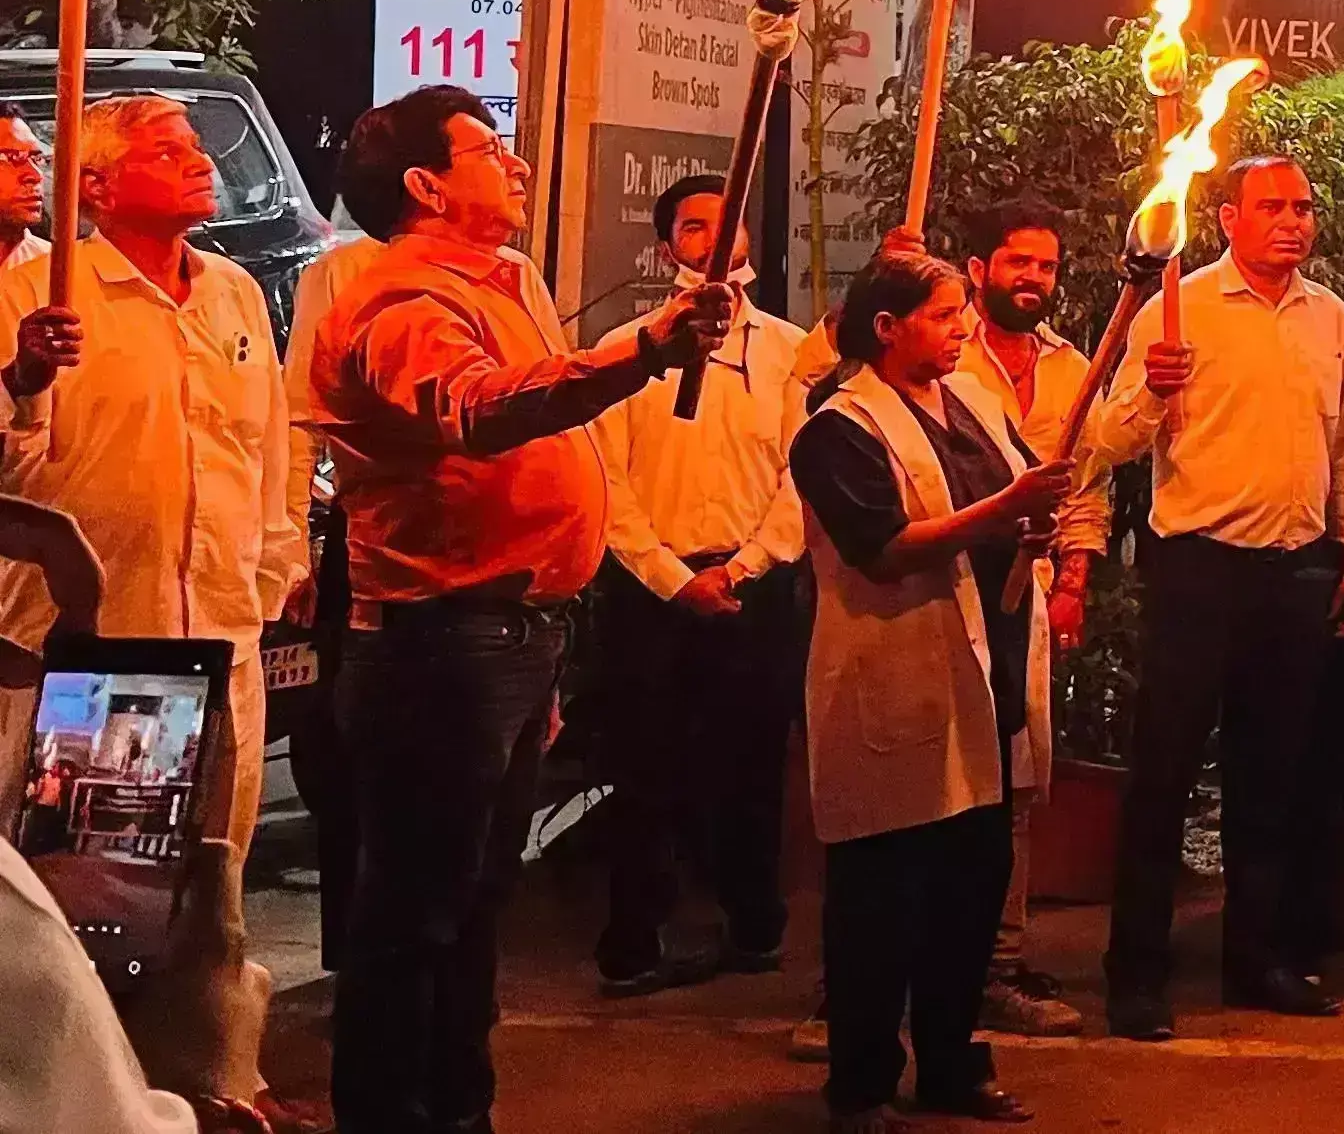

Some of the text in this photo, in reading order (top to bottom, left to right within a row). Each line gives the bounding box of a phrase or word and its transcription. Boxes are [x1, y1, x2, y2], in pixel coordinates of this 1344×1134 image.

[400, 26, 484, 79] 111
[637, 21, 662, 55] Skin
[664, 26, 697, 62] Detan
[709, 35, 739, 67] Facial
[1224, 16, 1336, 60] VIVEK
[652, 70, 720, 111] Brown Spots
[623, 151, 646, 196] Dr.
